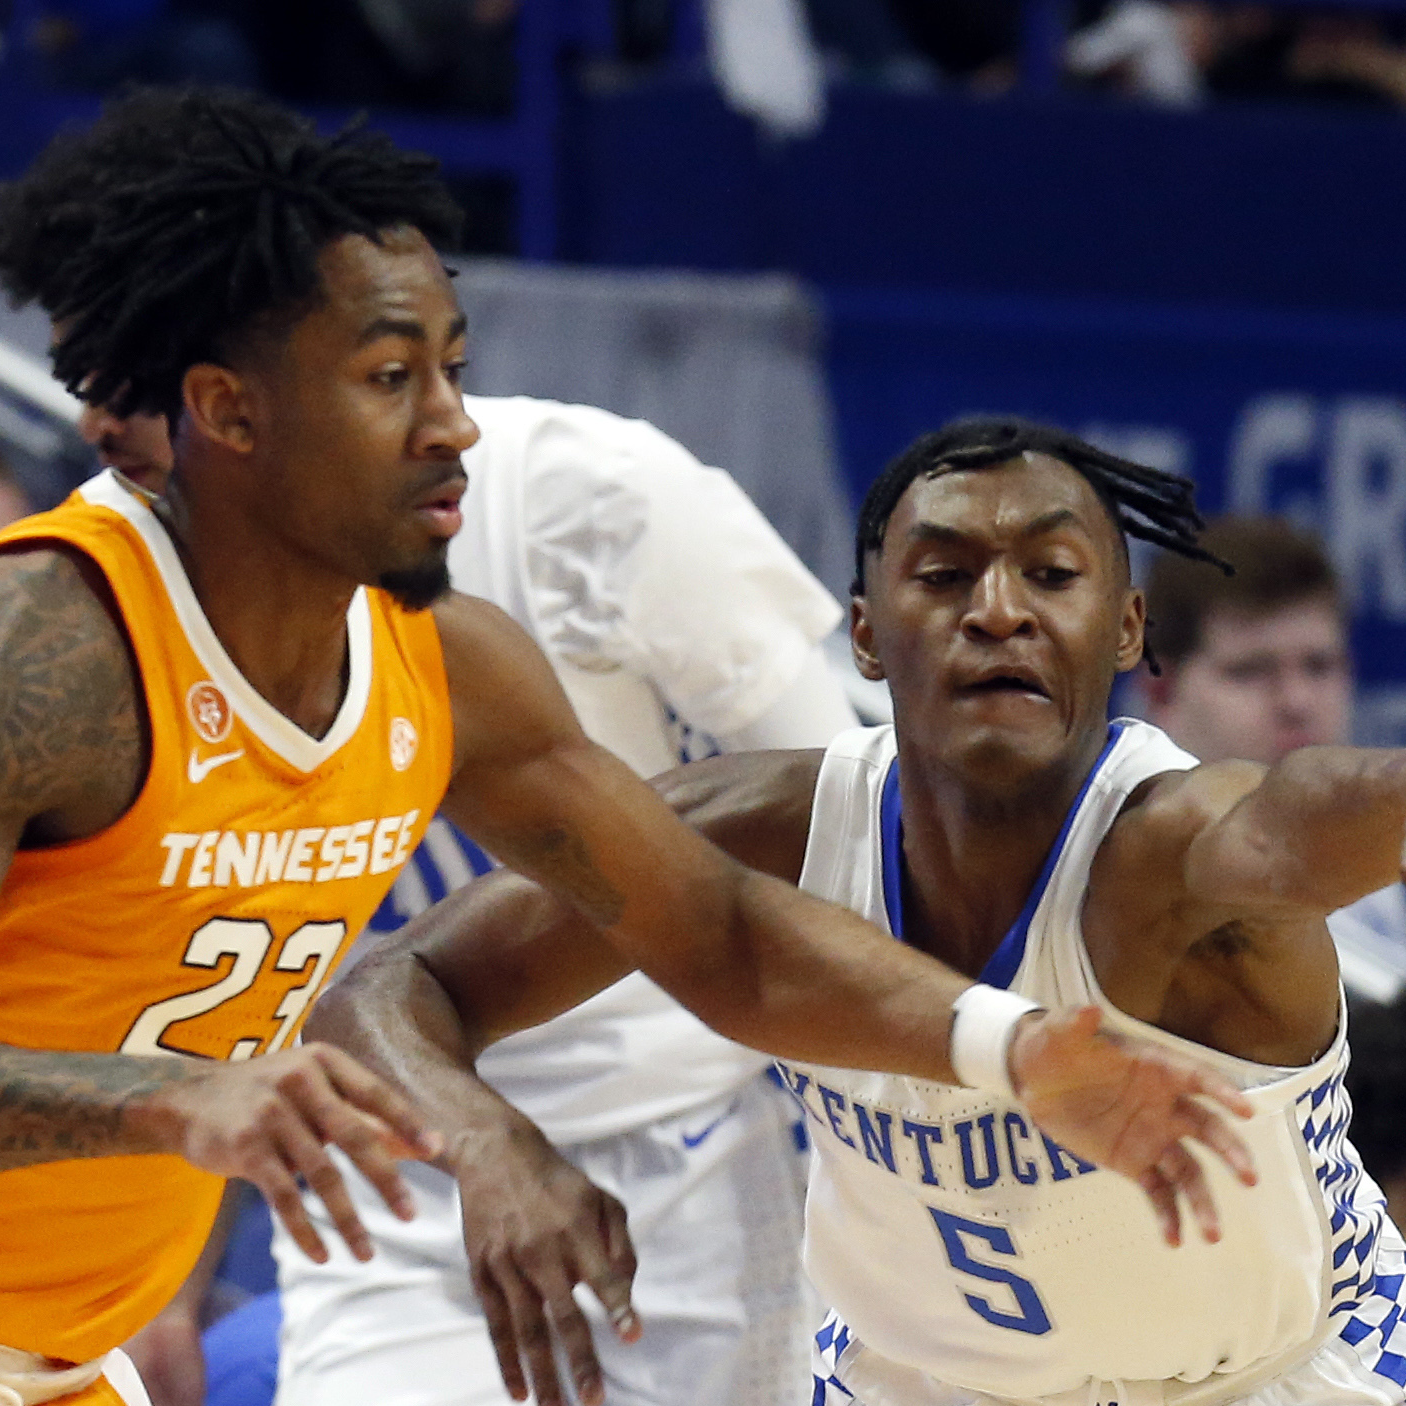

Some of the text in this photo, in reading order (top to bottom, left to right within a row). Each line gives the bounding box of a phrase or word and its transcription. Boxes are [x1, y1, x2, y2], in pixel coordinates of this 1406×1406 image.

[158, 808, 421, 889] TENNESSEE
[118, 914, 347, 1061] 23
[775, 1060, 1098, 1190] KENTUCK
[928, 1204, 1058, 1337] 5
